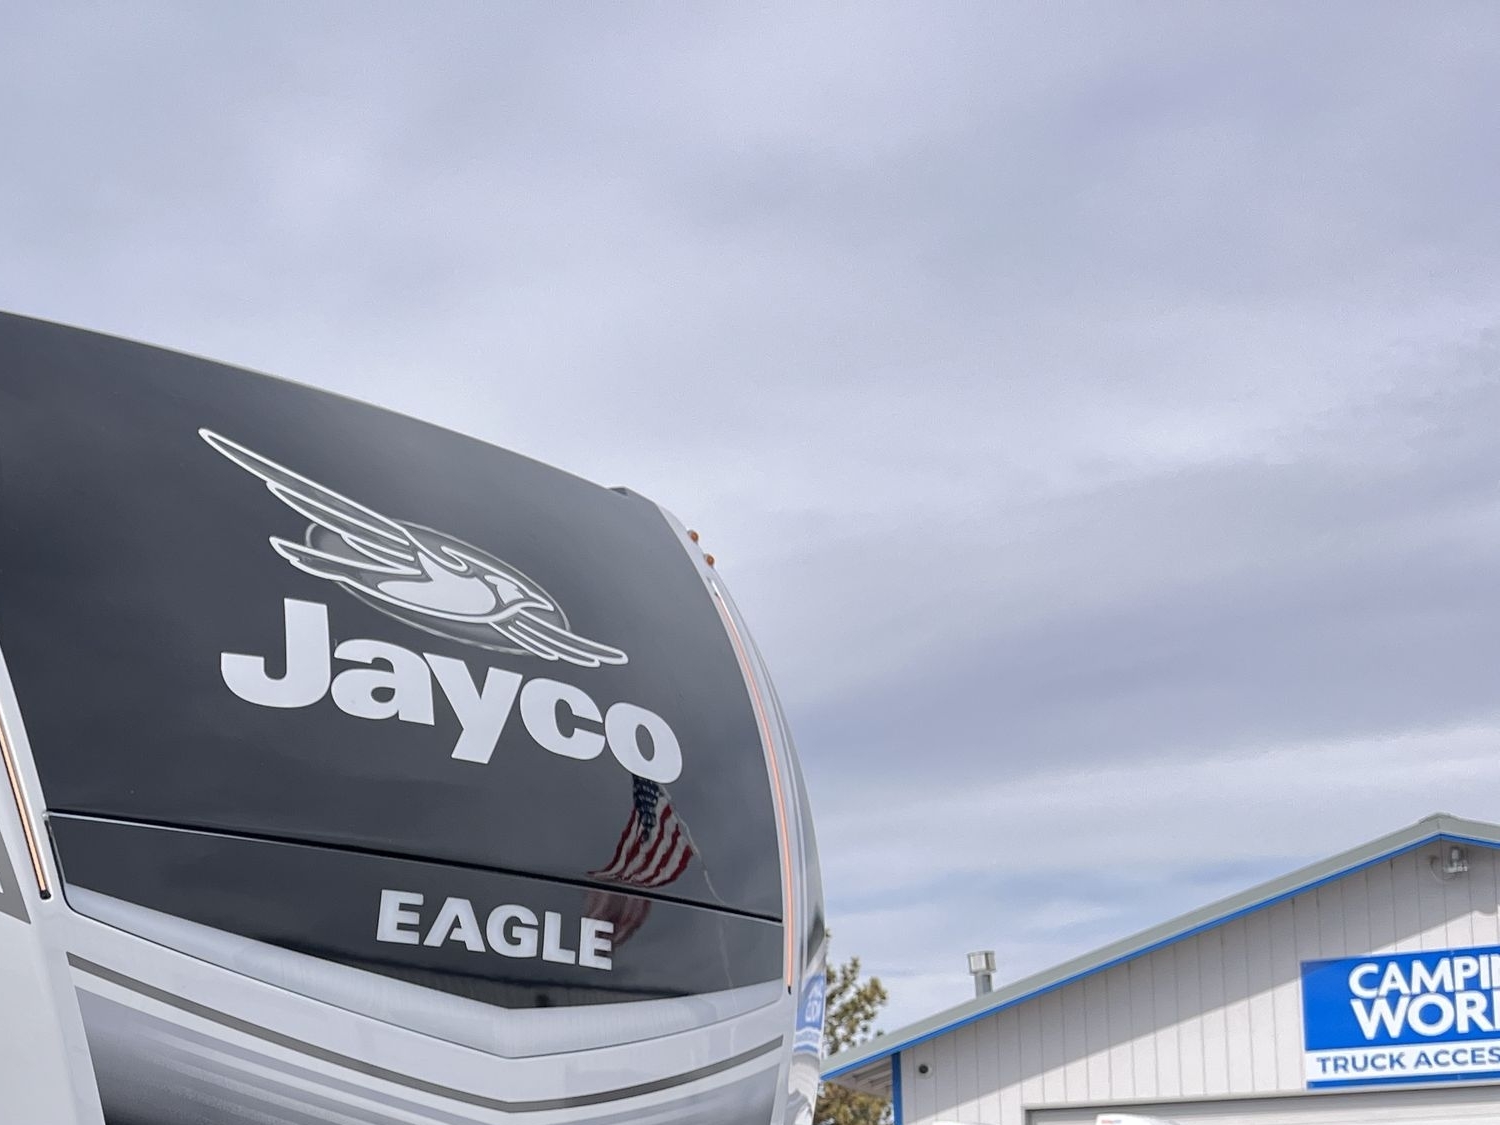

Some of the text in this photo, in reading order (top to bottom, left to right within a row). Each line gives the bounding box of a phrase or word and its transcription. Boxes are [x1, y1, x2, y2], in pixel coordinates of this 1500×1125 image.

[220, 597, 683, 784] Jayco
[376, 888, 615, 971] EAGLE
[1348, 953, 1500, 999] CAMPI
[1316, 1052, 1406, 1074] TRUCK
